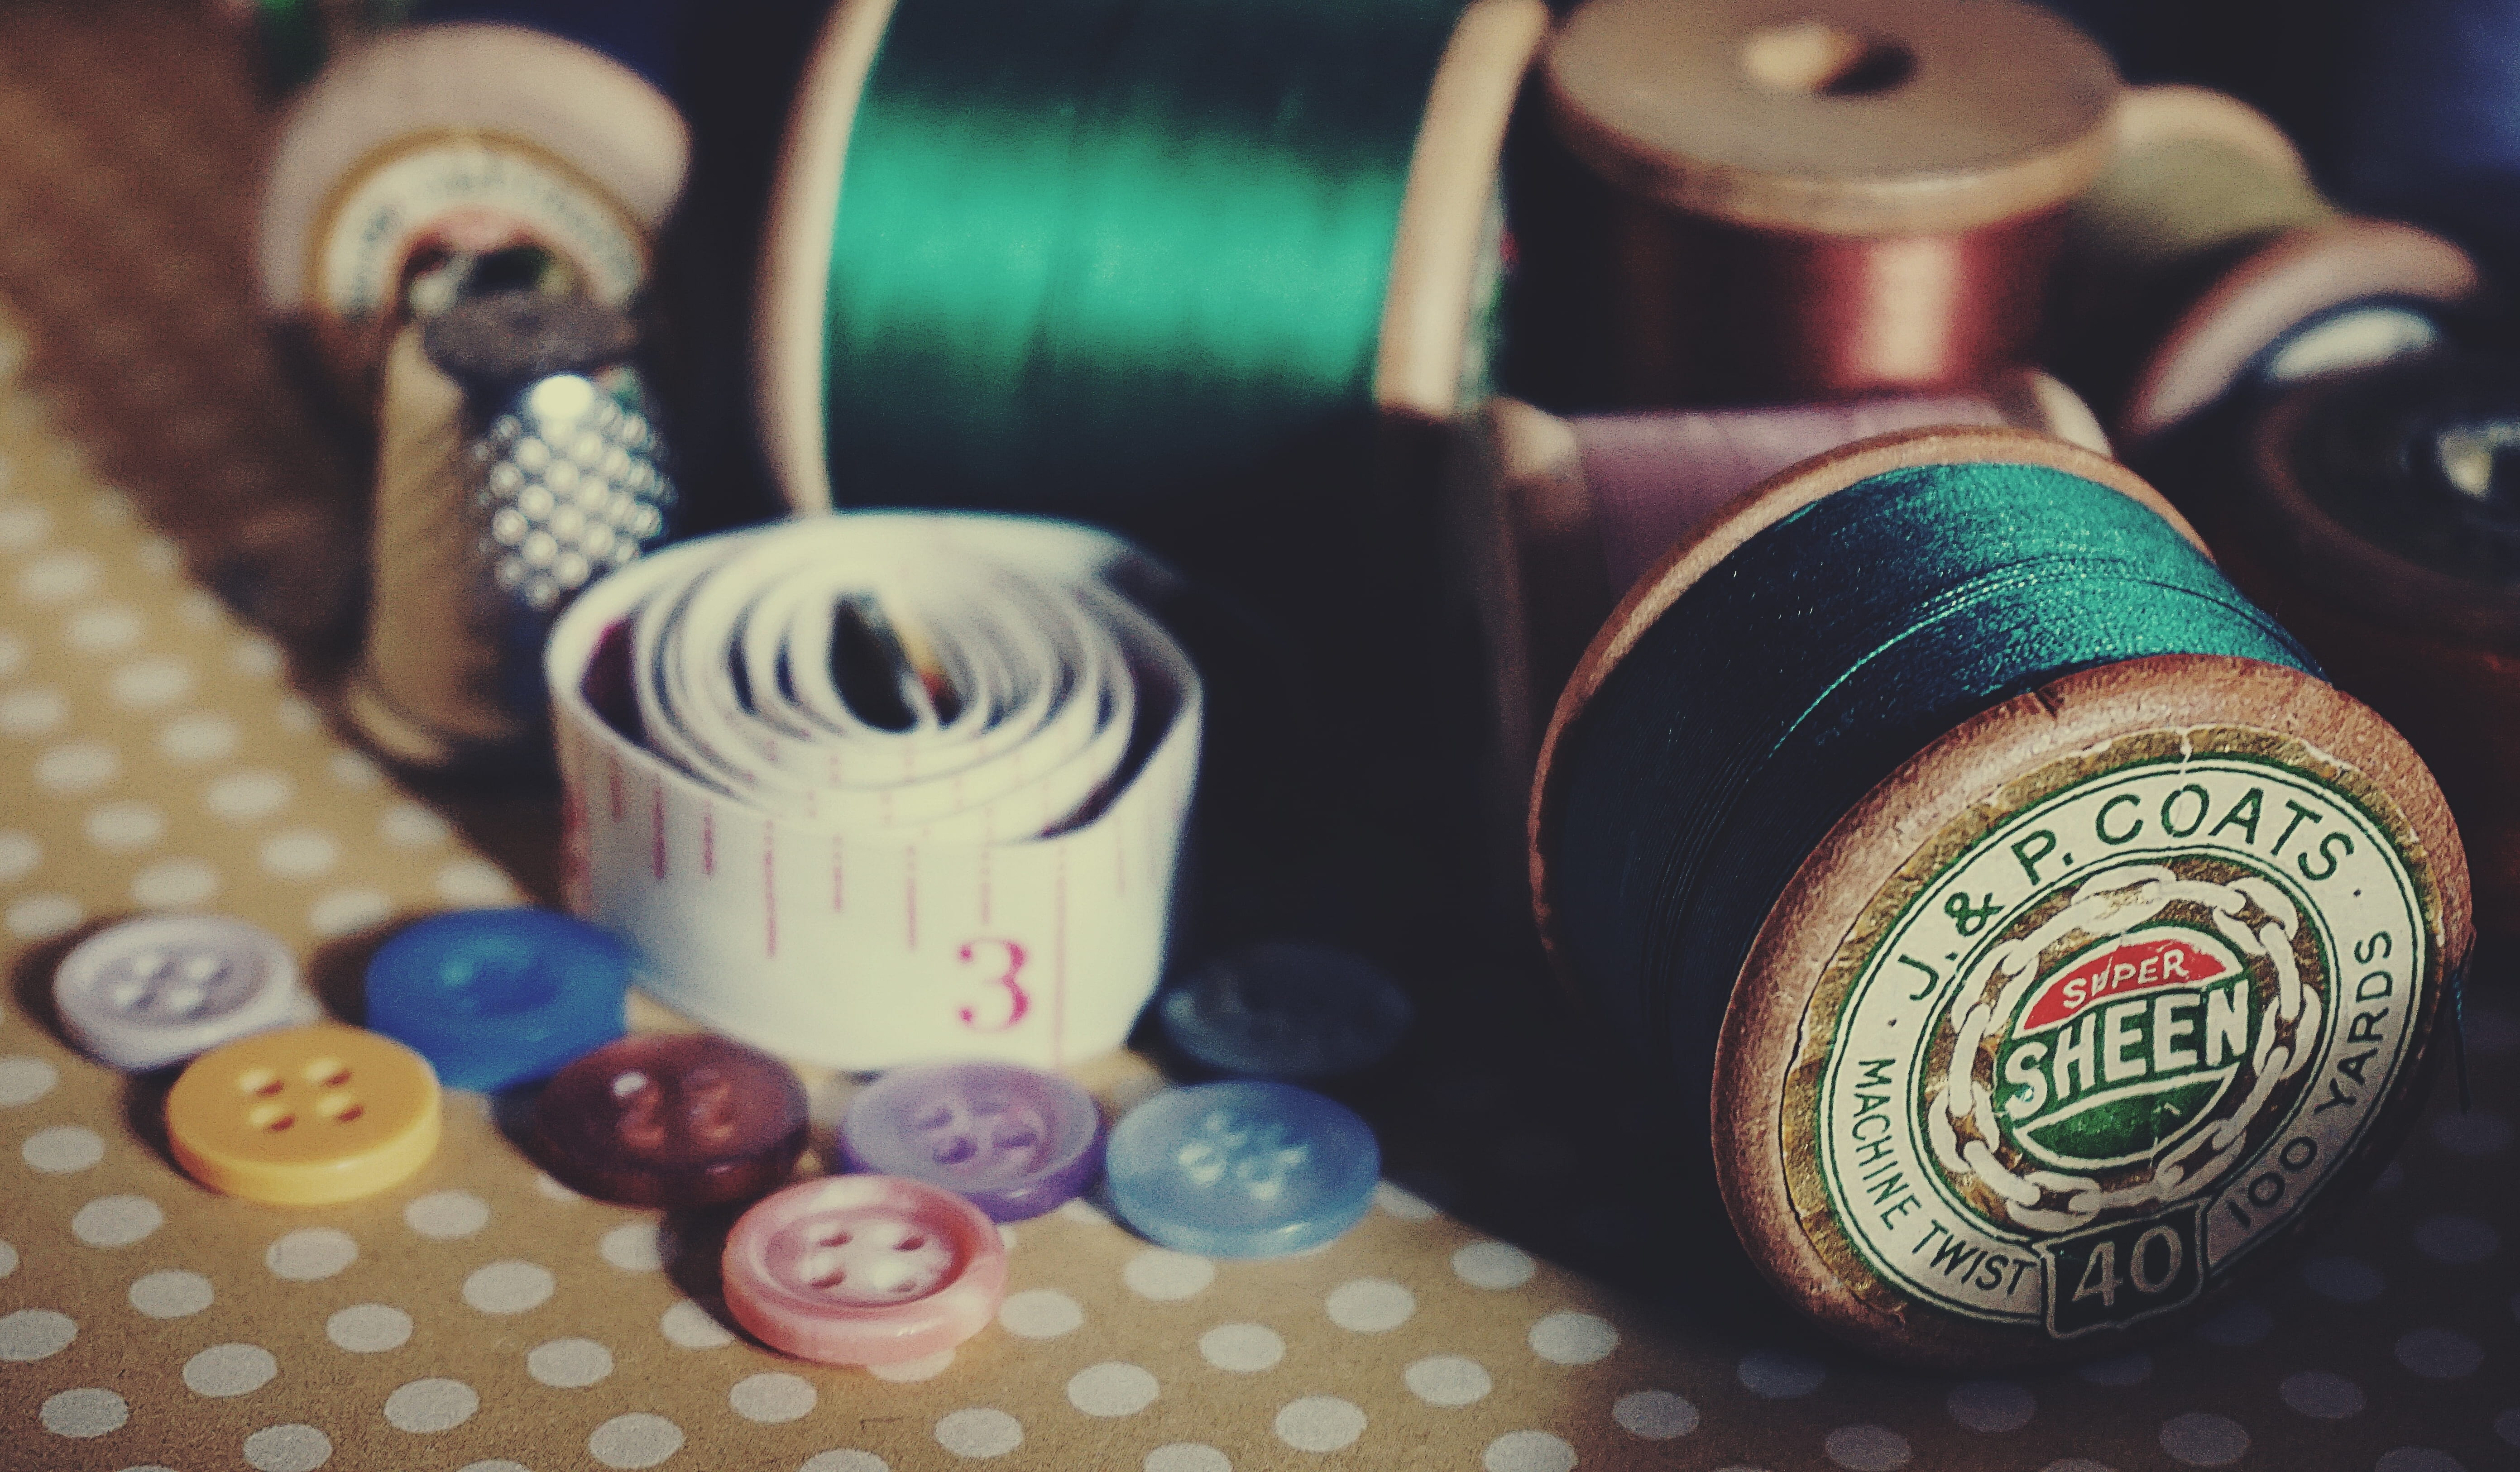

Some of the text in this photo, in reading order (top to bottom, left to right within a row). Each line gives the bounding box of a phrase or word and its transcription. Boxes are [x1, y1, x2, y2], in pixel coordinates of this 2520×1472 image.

[2095, 783, 2355, 881] COATS
[956, 936, 1032, 1034] 3
[2062, 949, 2190, 1009] SUPER
[2004, 979, 2249, 1120] SHEEN
[2229, 930, 2393, 1230] 100 YARDS
[1851, 1057, 2038, 1295] MACHINE TWIST
[2072, 1224, 2183, 1307] 40
